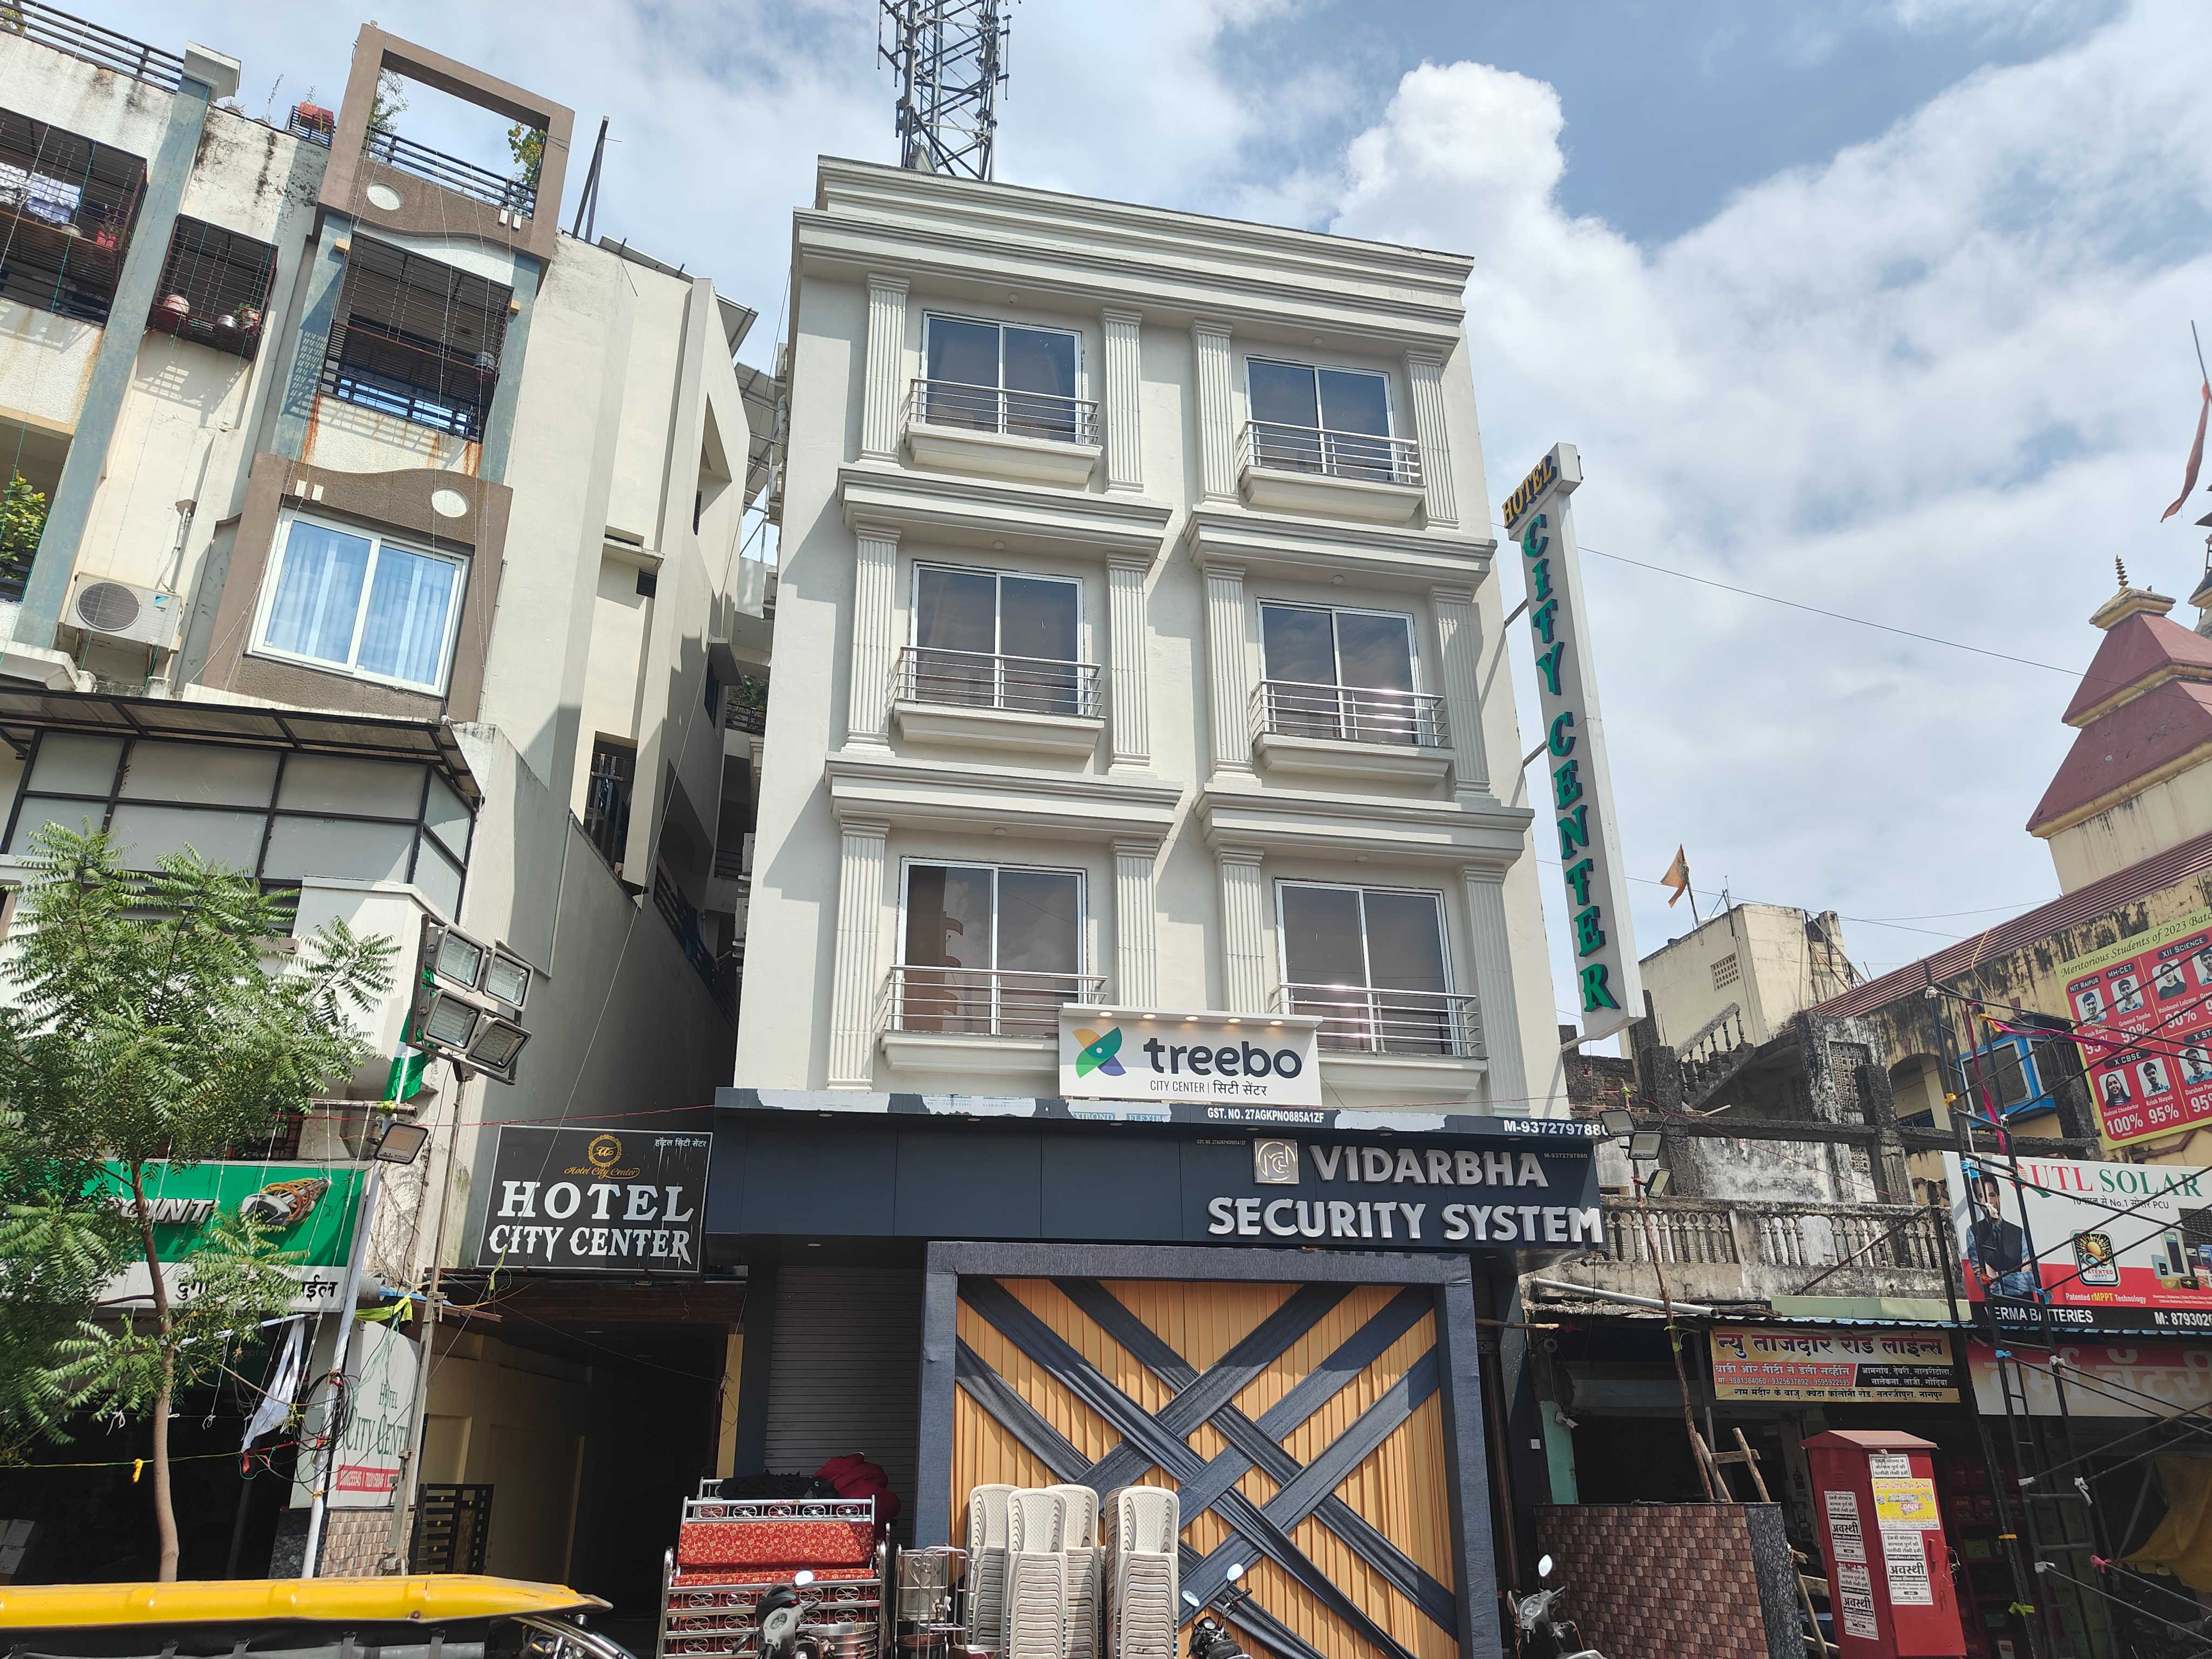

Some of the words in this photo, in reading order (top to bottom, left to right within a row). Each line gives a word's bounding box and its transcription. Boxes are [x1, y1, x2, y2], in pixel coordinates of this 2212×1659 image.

[1502, 455, 1557, 529] HOTEL
[1521, 514, 1566, 697] CITY
[1548, 711, 1621, 1012] CENTER
[2061, 954, 2109, 977] Meritorious
[2111, 938, 2150, 959] Students
[2152, 928, 2163, 943] of
[2164, 921, 2187, 937] 2023
[2189, 912, 2212, 926] Batc
[2162, 949, 2172, 958] XII
[2175, 938, 2204, 953] SCIENCE
[2069, 984, 2079, 992] NIT
[2080, 977, 2099, 988] RAIPUR
[1143, 1037, 1301, 1079] treebo
[2121, 1051, 2141, 1063] CBSE
[1150, 1080, 1169, 1091] CITY
[1172, 1081, 1205, 1094] CENTER
[1212, 1080, 1239, 1095] सिटी
[1242, 1081, 1267, 1096] सेंटर
[2149, 1103, 2179, 1124] 95%
[2107, 1113, 2143, 1135] 100%
[675, 1137, 690, 1147] सिटी
[692, 1138, 706, 1147] सेंटर
[564, 1166, 592, 1175] Hotel
[611, 1168, 640, 1179] Center
[1309, 1145, 1549, 1188] VIDARBHA
[2029, 1164, 2093, 1192] UTL
[2099, 1169, 2203, 1197] SOLAR
[497, 1181, 694, 1222] HOTEL
[2110, 1199, 2128, 1208] No.1
[2153, 1201, 2169, 1209] PCU
[1208, 1197, 1426, 1239] SECURITY
[1442, 1204, 1603, 1244] SYSTEM
[489, 1224, 564, 1262] CITY
[569, 1226, 692, 1265] CENTER
[2065, 1293, 2090, 1301] Patented
[2091, 1292, 2113, 1302] rMPPT
[2114, 1294, 2146, 1304] Technology
[2154, 1312, 2169, 1325] M:
[1750, 1333, 1833, 1357] ताजदार
[1838, 1331, 1873, 1354] रोड
[1880, 1332, 1943, 1358] लाईन्स
[1741, 1363, 1758, 1373] और
[1786, 1363, 1795, 1374] से
[1798, 1364, 1817, 1375] डेली
[1773, 1387, 1781, 1395] के
[377, 1414, 408, 1456] CENT
[1832, 1522, 1858, 1534] अवस्थी
[1890, 1562, 1925, 1574] अवस्थी
[1843, 1596, 1871, 1609] अवस्थी
